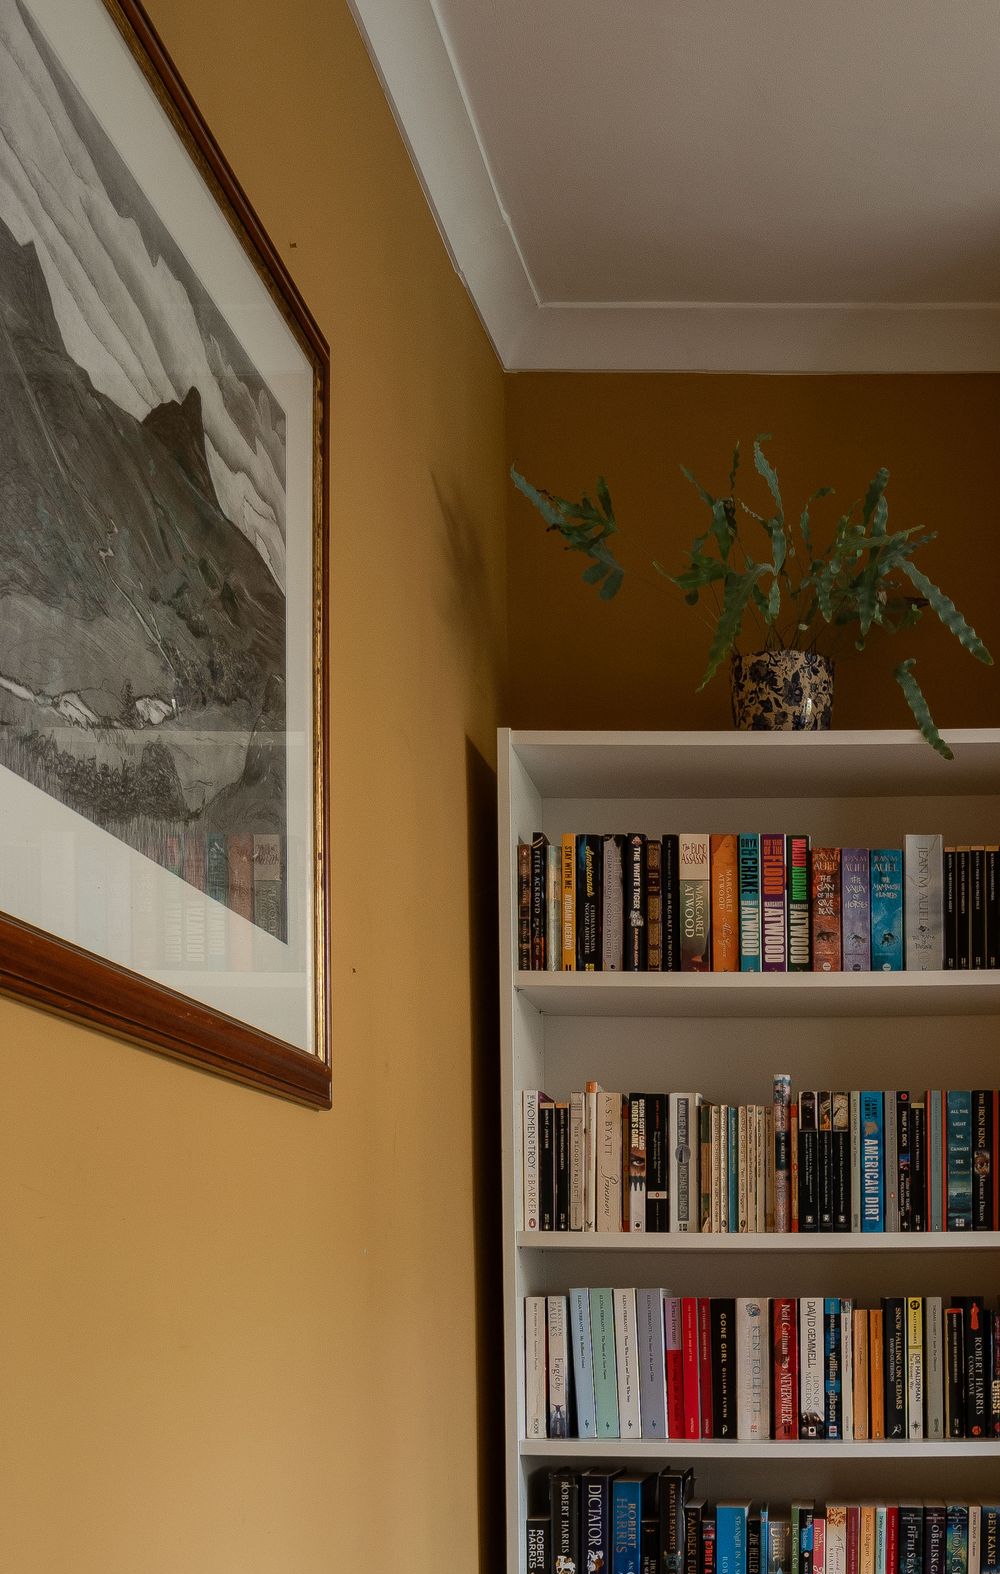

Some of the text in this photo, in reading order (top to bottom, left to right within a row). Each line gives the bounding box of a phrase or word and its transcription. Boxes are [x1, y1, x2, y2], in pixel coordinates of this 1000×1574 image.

[565, 880, 572, 889] ME
[585, 846, 596, 897] Americanah
[742, 858, 758, 894] CRAKE
[764, 855, 784, 895] FLOOD
[792, 838, 807, 900] MADDADDAM
[918, 847, 928, 926] JEAN AUEL
[684, 884, 694, 938] ATWOOD
[696, 884, 704, 938] MARGARET
[742, 906, 759, 956] ATWOOD
[764, 908, 784, 963] ATWOOD
[790, 910, 810, 964] ATWOOD
[605, 1096, 612, 1104] A.
[605, 1109, 612, 1118] S.
[978, 1106, 986, 1126] IRON
[527, 1101, 536, 1169] WOMEN TROY
[978, 1128, 986, 1148] KING
[527, 1180, 536, 1214] BARKER
[864, 1138, 880, 1222] AMERICAN DIRT
[781, 1304, 791, 1354] Neil Gaiman
[804, 1301, 816, 1368] DAVID GEMMELL
[552, 1358, 563, 1391] Engleby
[752, 1326, 760, 1414] KEN FOLLETT
[827, 1352, 838, 1422] william gibson
[895, 1366, 902, 1378] ON
[974, 1337, 984, 1414] ROBERT HARRIS
[780, 1372, 792, 1424] NEVERWHERE
[813, 1396, 820, 1407] OF
[588, 1485, 602, 1546] DICTATOR
[616, 1496, 627, 1553] HARRIS
[628, 1503, 636, 1548] ROBERT
[668, 1482, 676, 1550] NATALIE HAYNES
[687, 1518, 697, 1556] AMBER
[908, 1525, 916, 1550] FIFTH
[988, 1512, 996, 1565] BEN KANE
[536, 1529, 544, 1568] ROBERT
[704, 1540, 713, 1566] ROBERT
[748, 1547, 758, 1574] HELLER
[930, 1525, 940, 1564] OBELISK
[952, 1524, 960, 1562] STONE
